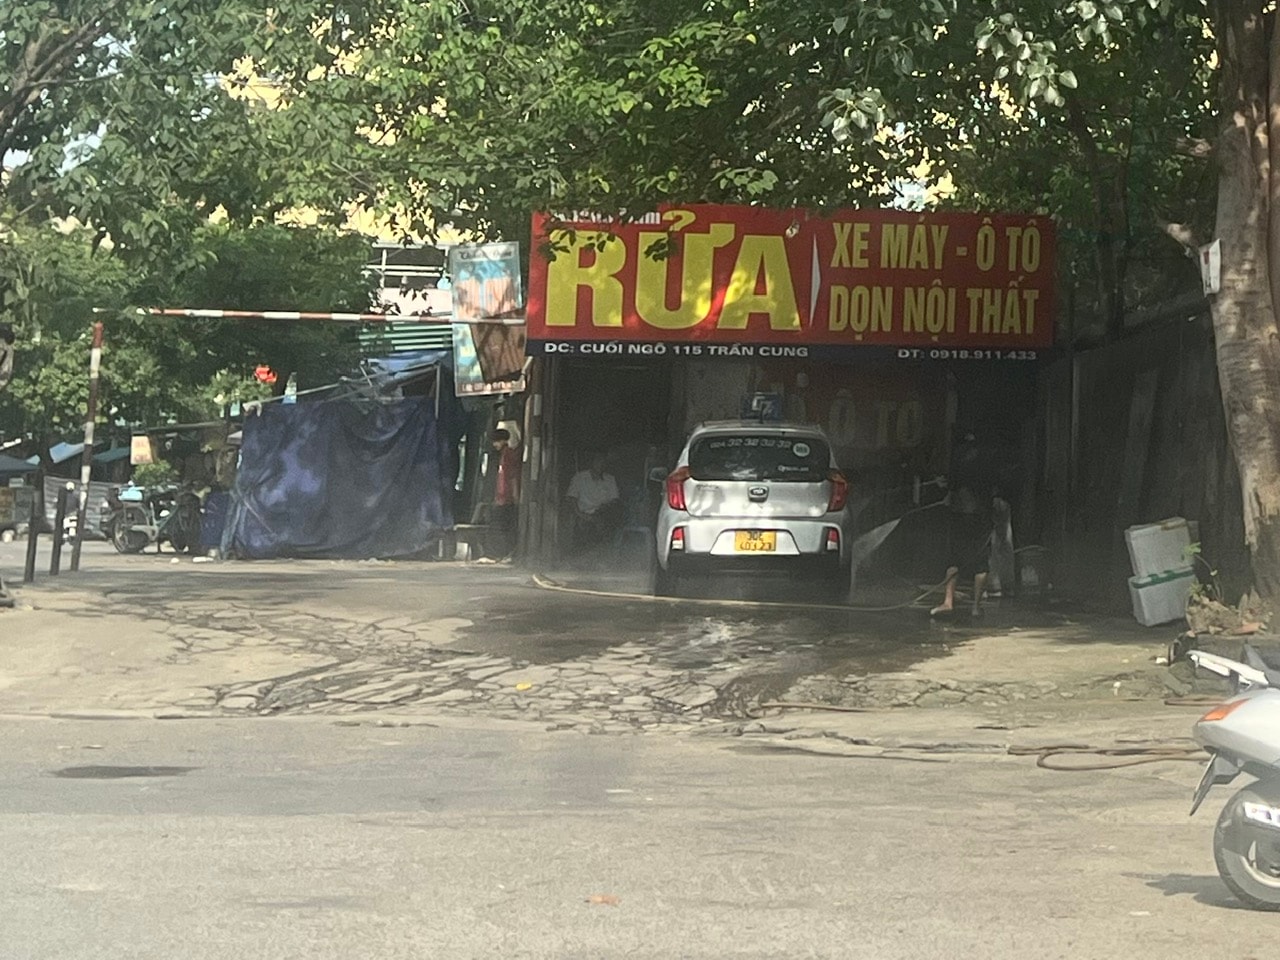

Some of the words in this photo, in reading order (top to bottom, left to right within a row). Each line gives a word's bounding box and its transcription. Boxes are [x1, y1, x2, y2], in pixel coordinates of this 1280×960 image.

[545, 209, 802, 331] RỬA
[830, 222, 870, 268] XE
[880, 215, 949, 270] MÁY
[976, 217, 995, 271] Ô
[1006, 219, 1041, 272] TÔ
[829, 285, 893, 340] DỌN
[903, 279, 956, 341] NỘI
[967, 275, 1039, 334] THẤT
[580, 340, 623, 354] CUỐI
[673, 345, 702, 356] 115
[759, 346, 809, 358] CUNG
